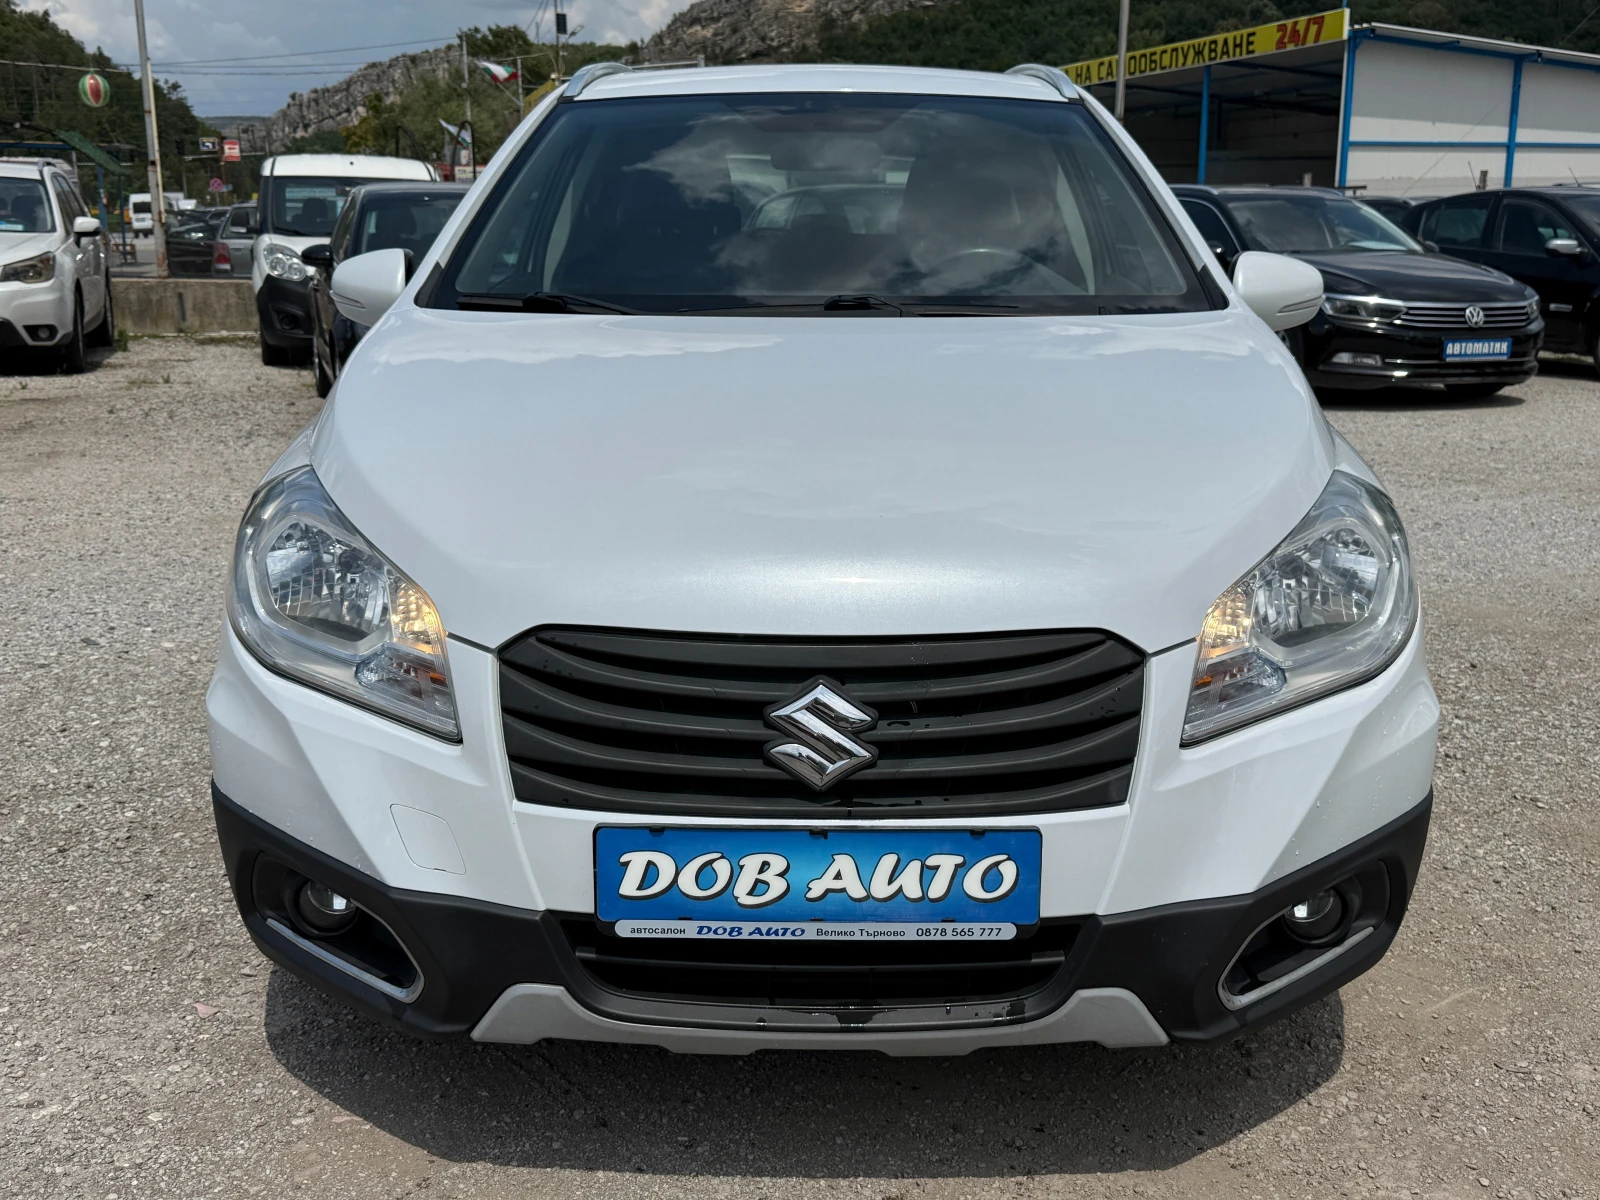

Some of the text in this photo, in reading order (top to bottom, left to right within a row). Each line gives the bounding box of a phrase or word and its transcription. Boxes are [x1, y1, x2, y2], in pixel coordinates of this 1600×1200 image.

[1075, 15, 1325, 84] НА САООБСЛУЖВАНЕ 24/7
[1446, 341, 1508, 355] АВТОМАТИК
[618, 849, 1020, 908] DOB AUTO
[630, 925, 1002, 939] автосалон DOB AUTO Велико Търново 0878 565 777
